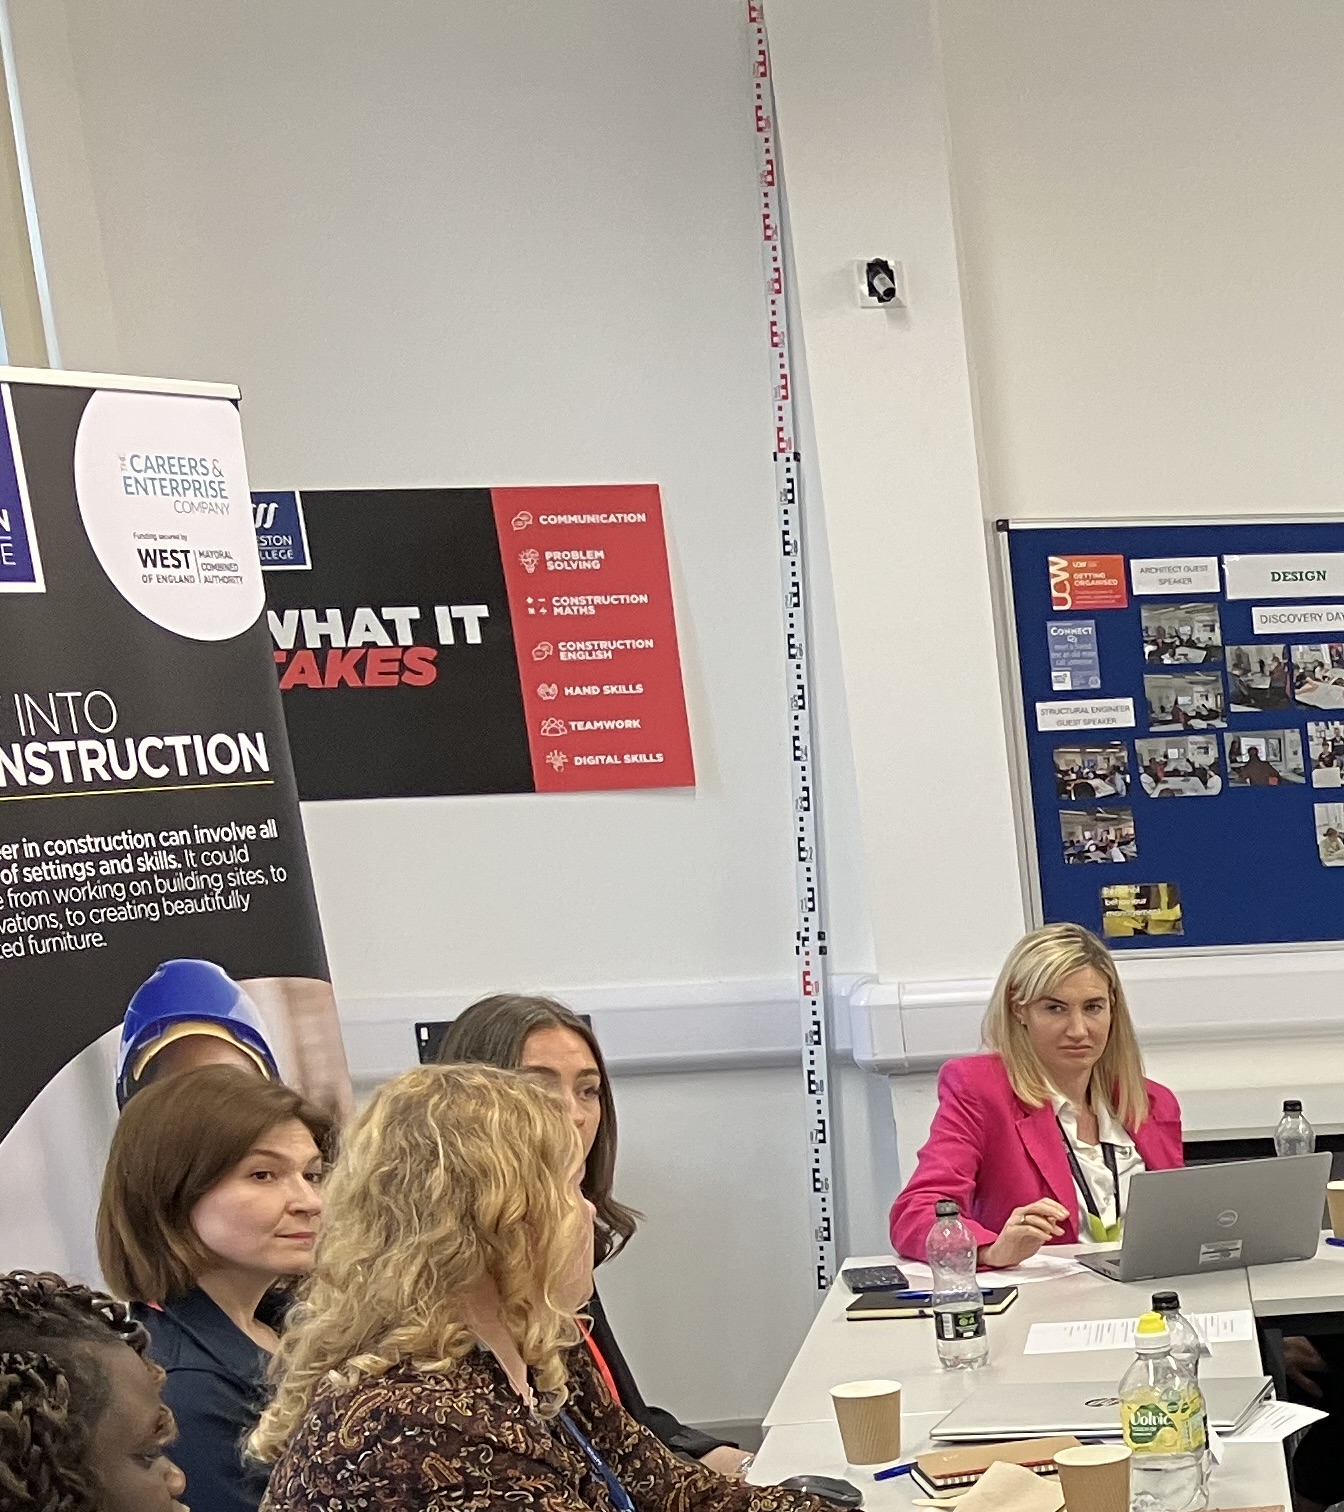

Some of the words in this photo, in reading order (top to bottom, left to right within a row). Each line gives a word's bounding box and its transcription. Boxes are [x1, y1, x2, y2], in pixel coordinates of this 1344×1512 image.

[130, 454, 209, 476] CAREERS
[212, 458, 224, 477] &
[123, 476, 228, 499] ENTERPRISE
[174, 500, 230, 515] COMPANY
[539, 513, 646, 524] COMMUNICATION
[137, 548, 191, 569] WEST
[545, 550, 604, 560] PROBLEM
[546, 560, 601, 570] SOLVING
[142, 575, 153, 583] OF
[157, 574, 195, 584] ENGLAND
[1158, 577, 1192, 586] SPEAKER
[1270, 570, 1327, 582] DESIGN
[552, 594, 648, 606] CONSTRUCTION
[553, 606, 595, 615] MATHS
[1260, 612, 1323, 624] DISCOVERY
[267, 607, 420, 649] WHAT
[434, 605, 490, 645] IT
[558, 639, 654, 651] CONSTRUCTION
[559, 650, 612, 661] ENGLISH
[564, 686, 600, 696] HAND
[603, 684, 644, 695] SKILLS
[14, 690, 118, 736] INTO
[1040, 707, 1089, 716] STRUCTURAL
[1091, 705, 1130, 713] ENGINEER
[568, 719, 641, 730] TEAMWORK
[1056, 719, 1081, 727] GUEST
[1083, 717, 1117, 725] SPEAKER
[574, 755, 621, 766] DIGITAL
[624, 753, 664, 764] SKILLS
[23, 838, 39, 859] in
[44, 830, 155, 856] construction
[159, 829, 190, 847] can
[194, 822, 256, 844] involve
[260, 819, 278, 839] all
[0, 866, 19, 884] of
[23, 858, 95, 883] settings
[100, 853, 133, 875] and
[137, 849, 182, 872] skills.
[185, 851, 197, 868] It
[201, 843, 249, 866] could
[8, 888, 50, 908] from
[53, 881, 126, 902] working
[129, 879, 151, 896] on
[155, 870, 223, 893] building
[228, 869, 269, 886] sites,
[270, 864, 287, 882] to
[65, 908, 86, 926] to
[89, 899, 161, 922] creating
[162, 891, 251, 917] beautifully
[28, 930, 107, 956] furniture.
[1131, 1411, 1174, 1426] Volvic
